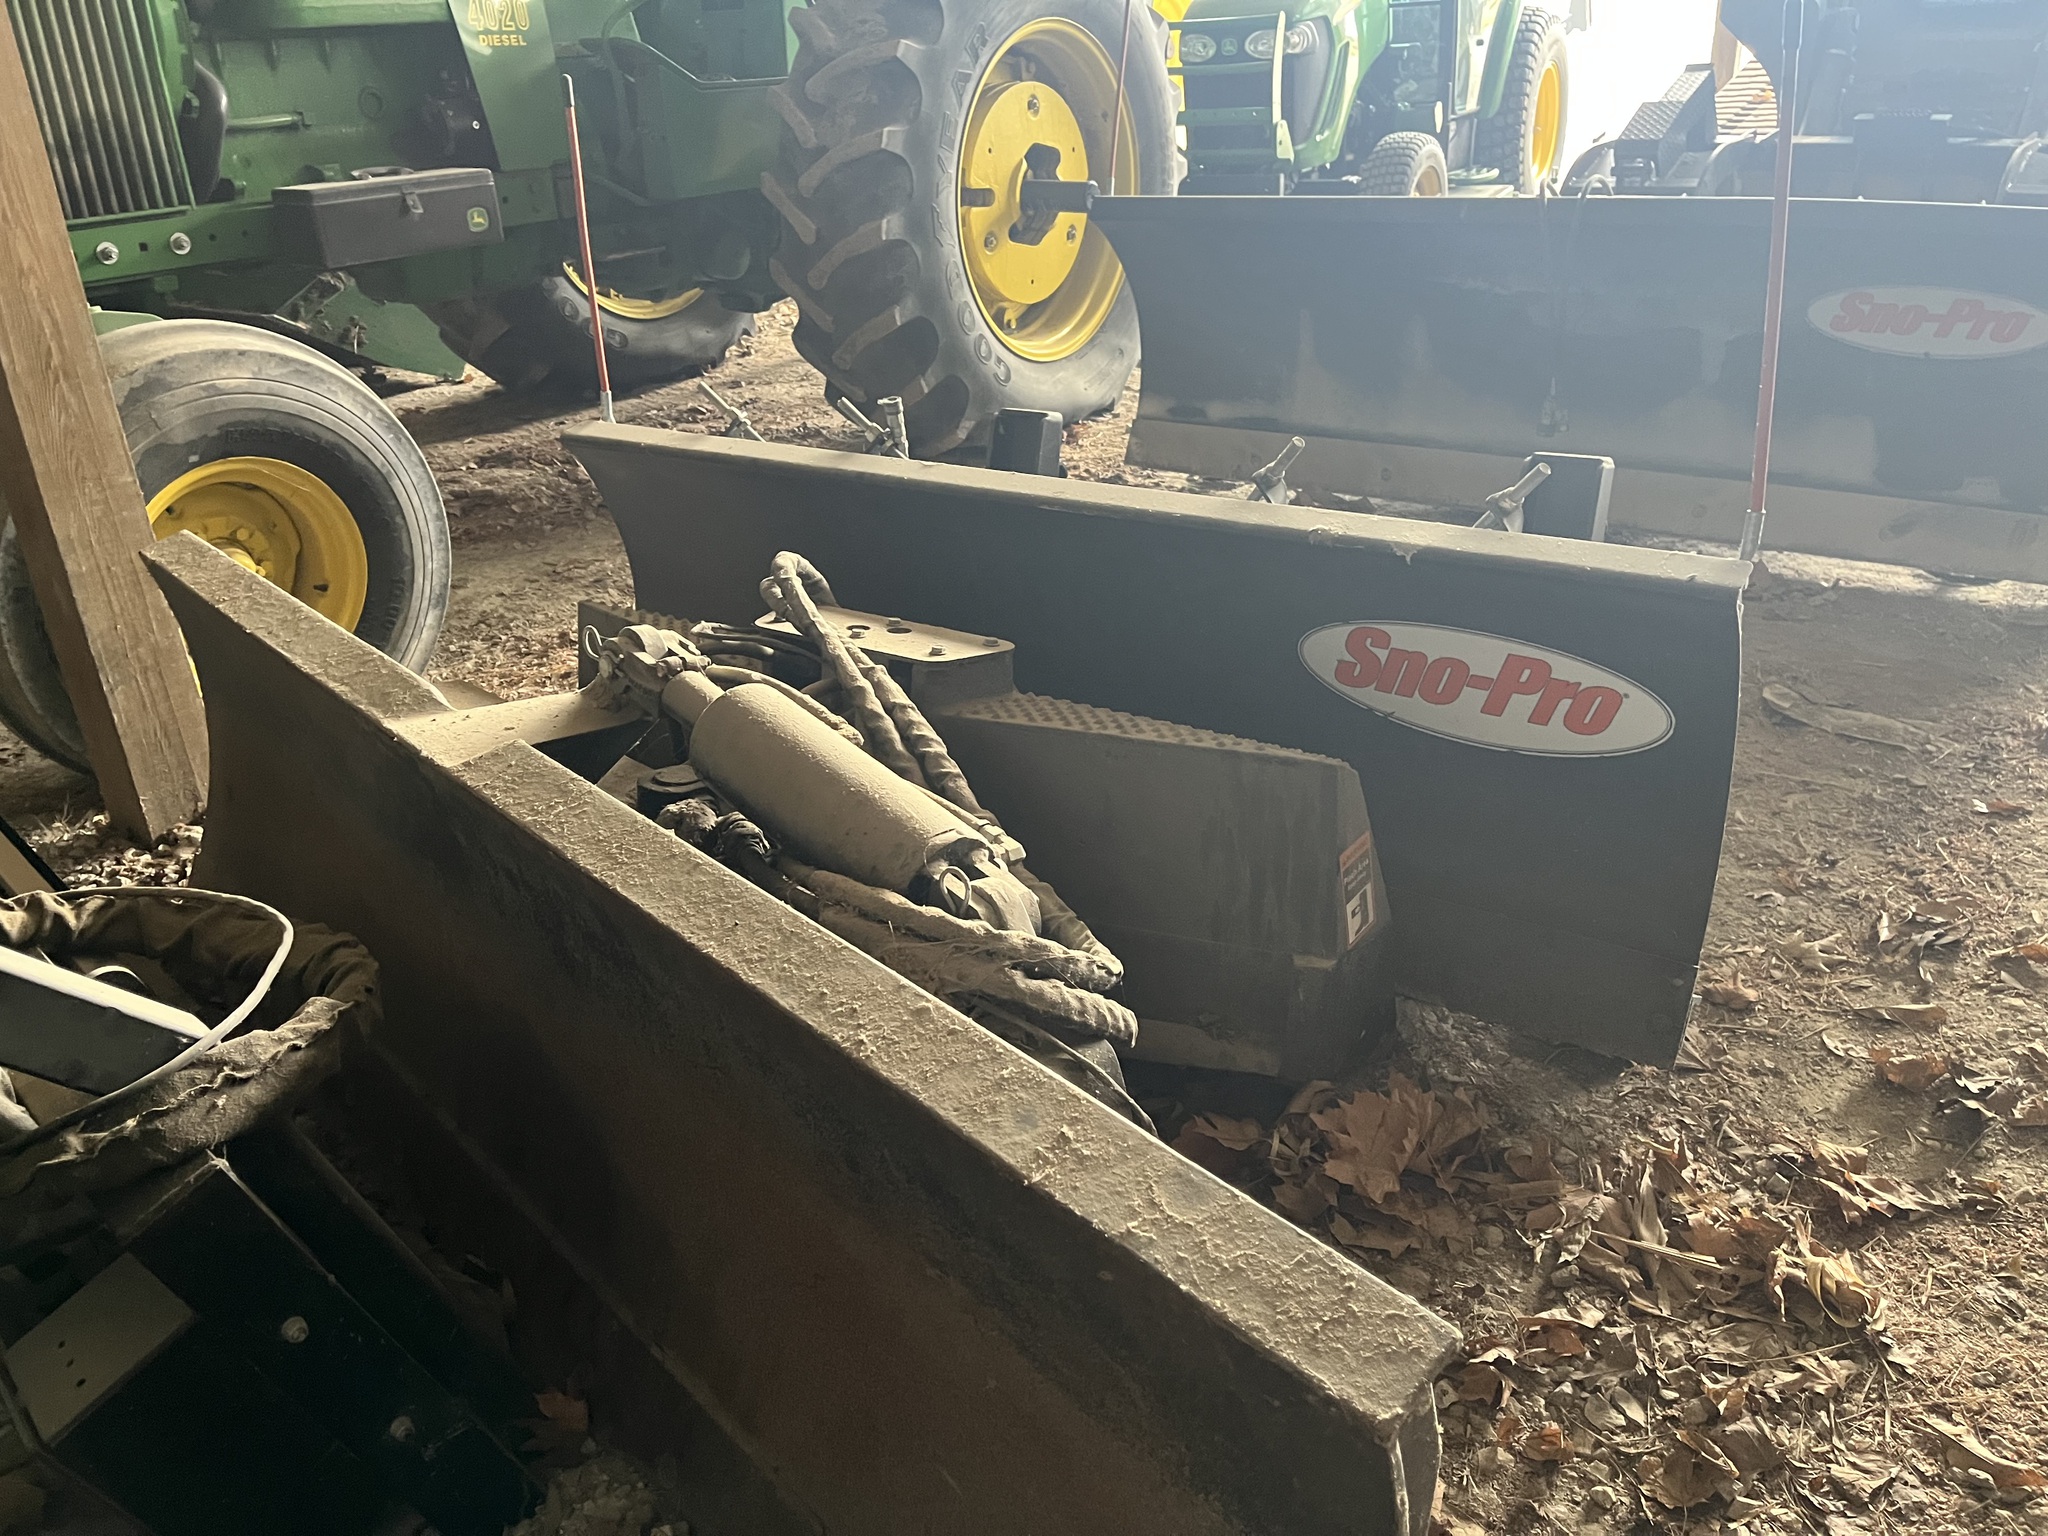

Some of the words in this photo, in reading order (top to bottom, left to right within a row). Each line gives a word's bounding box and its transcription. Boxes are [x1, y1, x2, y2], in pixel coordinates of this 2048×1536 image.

[468, 0, 530, 31] 4020
[479, 34, 527, 46] DIESEL
[1829, 291, 2033, 343] Sno-Pro
[1334, 626, 1624, 736] Sno-Pro
